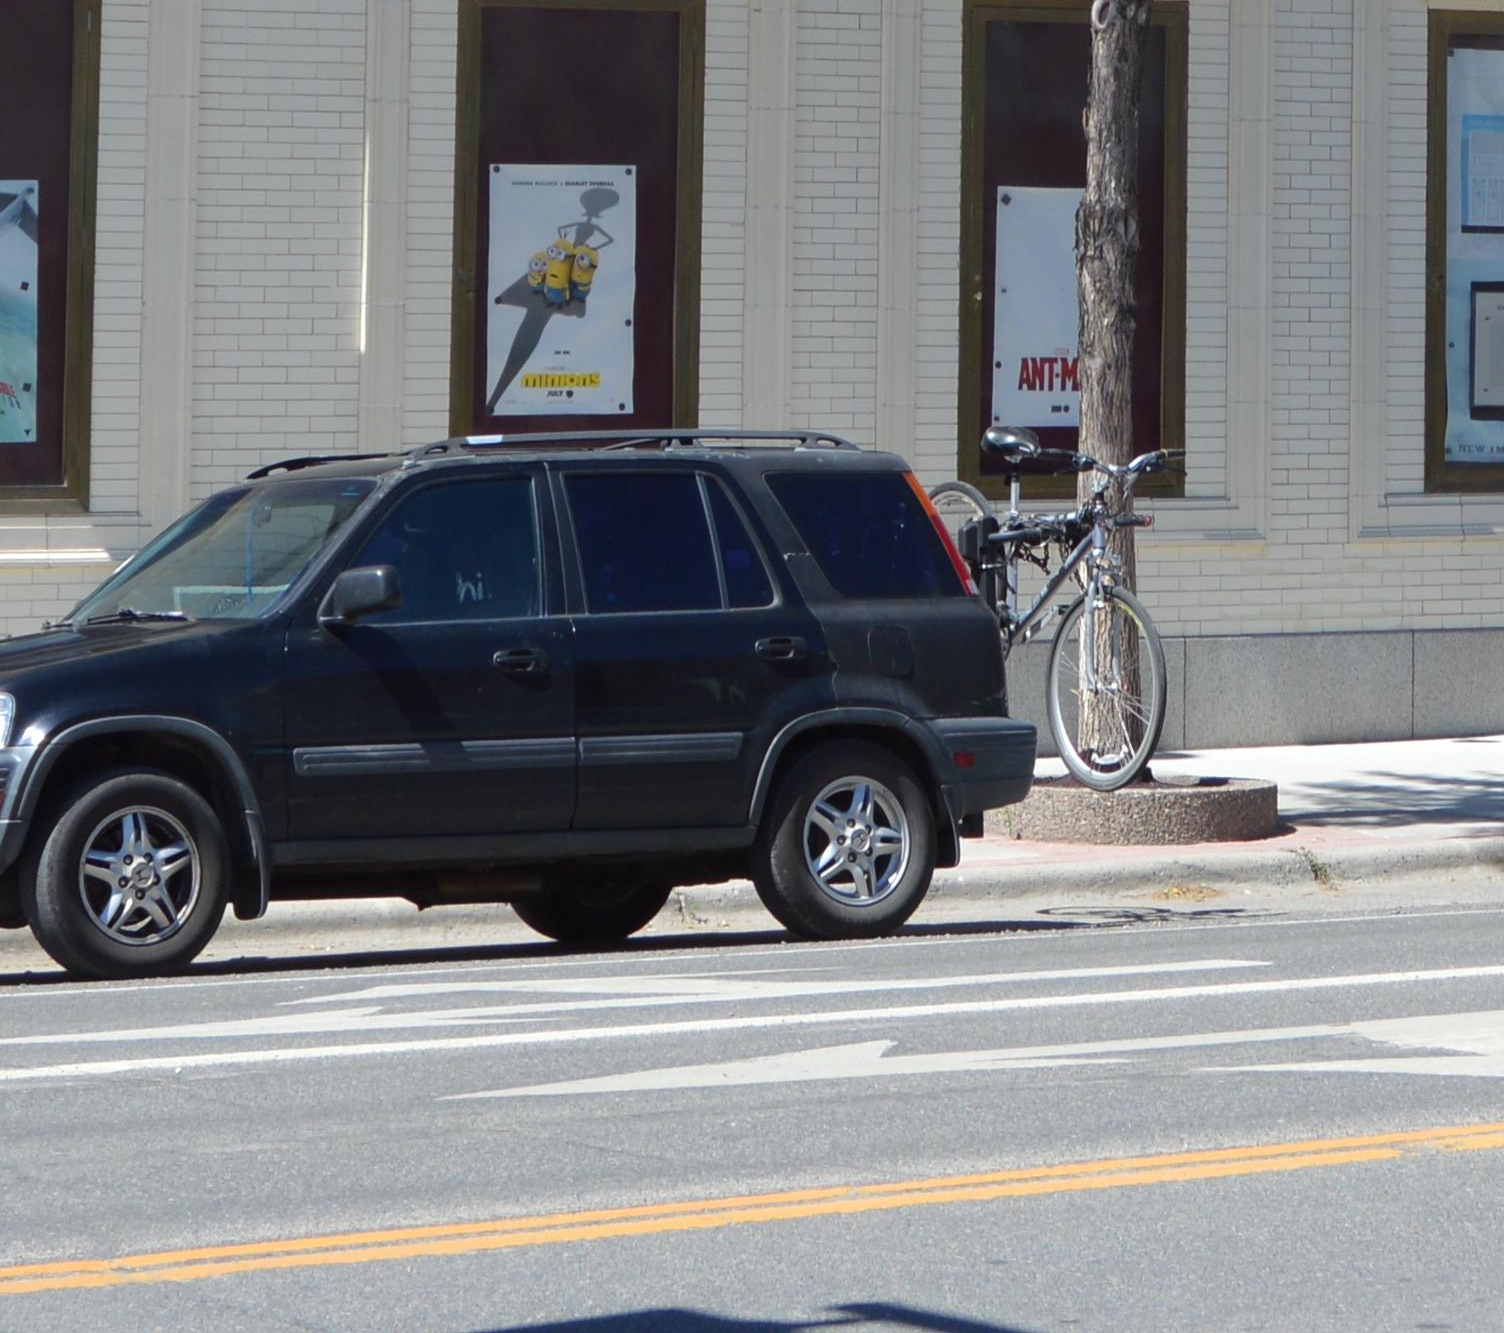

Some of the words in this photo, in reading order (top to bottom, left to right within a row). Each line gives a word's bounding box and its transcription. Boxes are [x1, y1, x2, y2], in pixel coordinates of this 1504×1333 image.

[523, 372, 600, 388] minions
[1017, 356, 1081, 392] ANT-M
[1457, 443, 1486, 455] NEW
